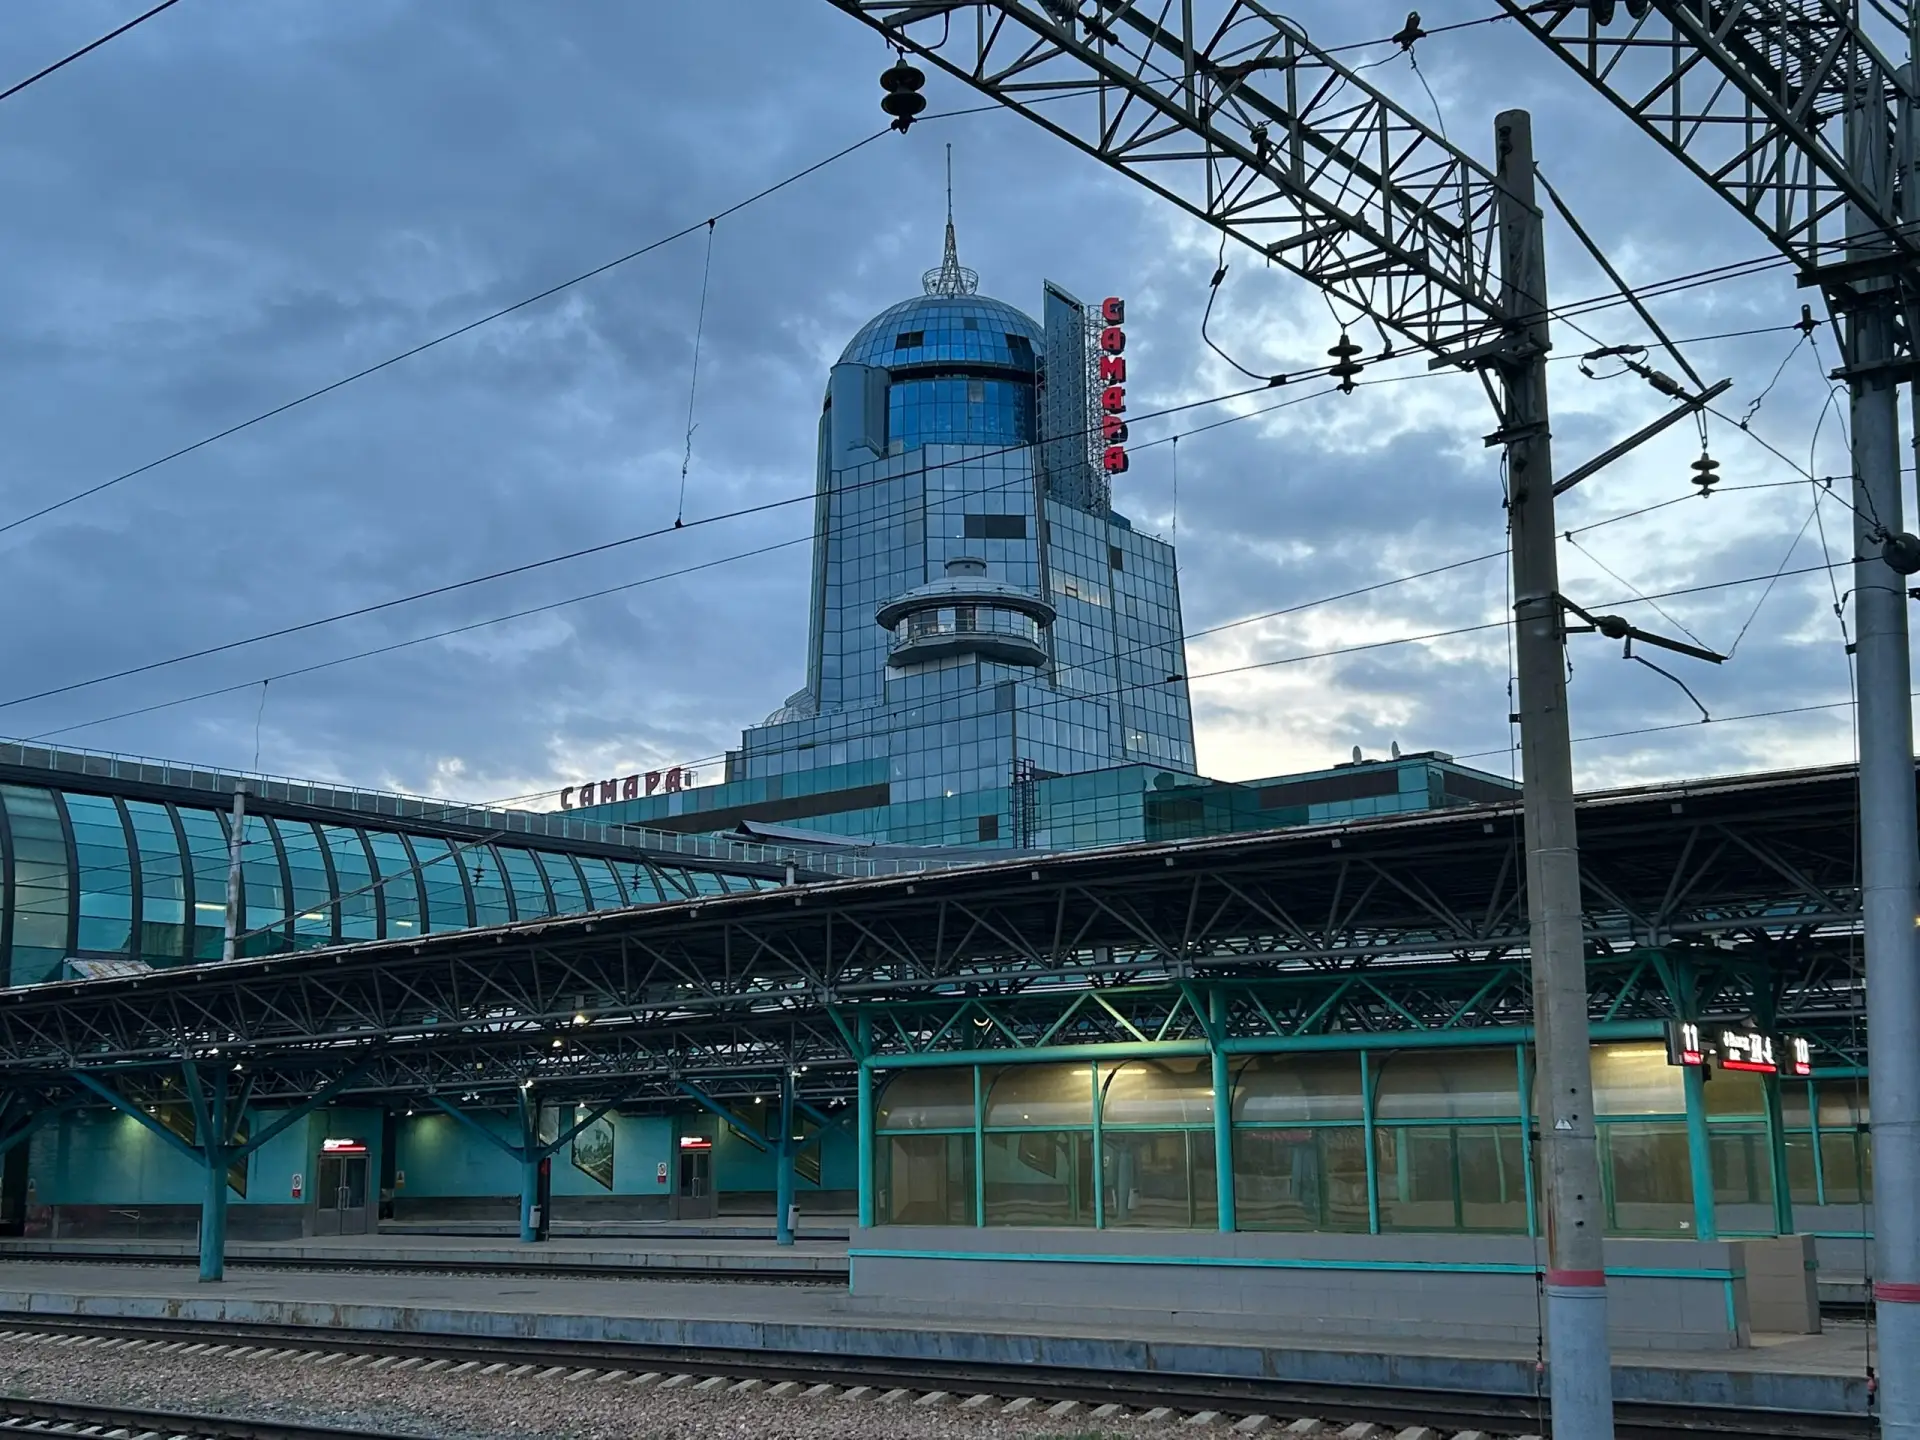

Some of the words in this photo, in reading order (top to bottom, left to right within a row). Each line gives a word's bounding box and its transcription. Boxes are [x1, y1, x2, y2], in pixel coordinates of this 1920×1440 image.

[1100, 297, 1127, 474] САМАРА
[560, 767, 683, 810] САМАРА
[1682, 1023, 1699, 1052] 11
[1794, 1037, 1810, 1064] 10
